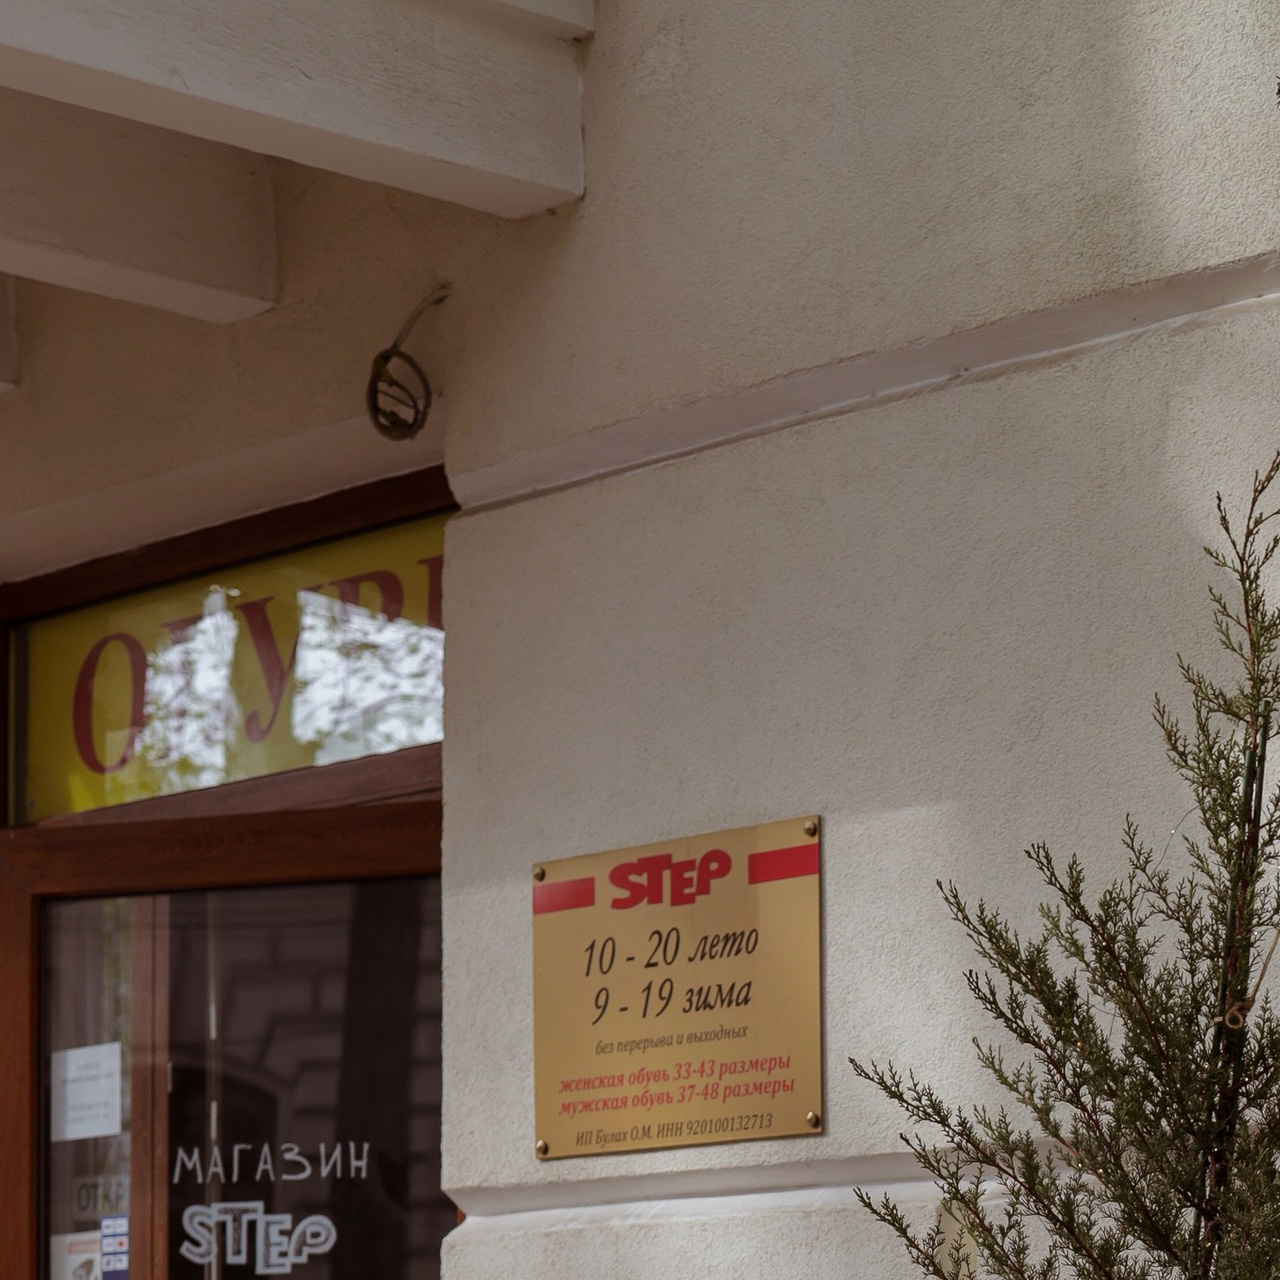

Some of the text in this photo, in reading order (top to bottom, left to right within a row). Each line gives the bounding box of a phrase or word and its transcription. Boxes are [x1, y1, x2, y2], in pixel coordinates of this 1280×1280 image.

[609, 849, 732, 909] STEP
[585, 937, 616, 976] 10
[644, 927, 680, 968] 20
[688, 929, 758, 962] лето
[592, 987, 609, 1025] 9
[641, 978, 674, 1019] 19
[683, 980, 752, 1014] зима
[596, 1026, 747, 1055] без перерыва и выходных
[559, 1054, 791, 1093] женская обувь 33-43 размеры
[559, 1078, 794, 1119] мужская обувь 37-48 размеры
[576, 1131, 592, 1146] ИП
[595, 1129, 627, 1147] Булах
[657, 1121, 683, 1138] ИНН
[686, 1113, 772, 1136] 920100132713
[173, 1141, 369, 1184] МАГАЗИН
[179, 1201, 337, 1275] STEP
